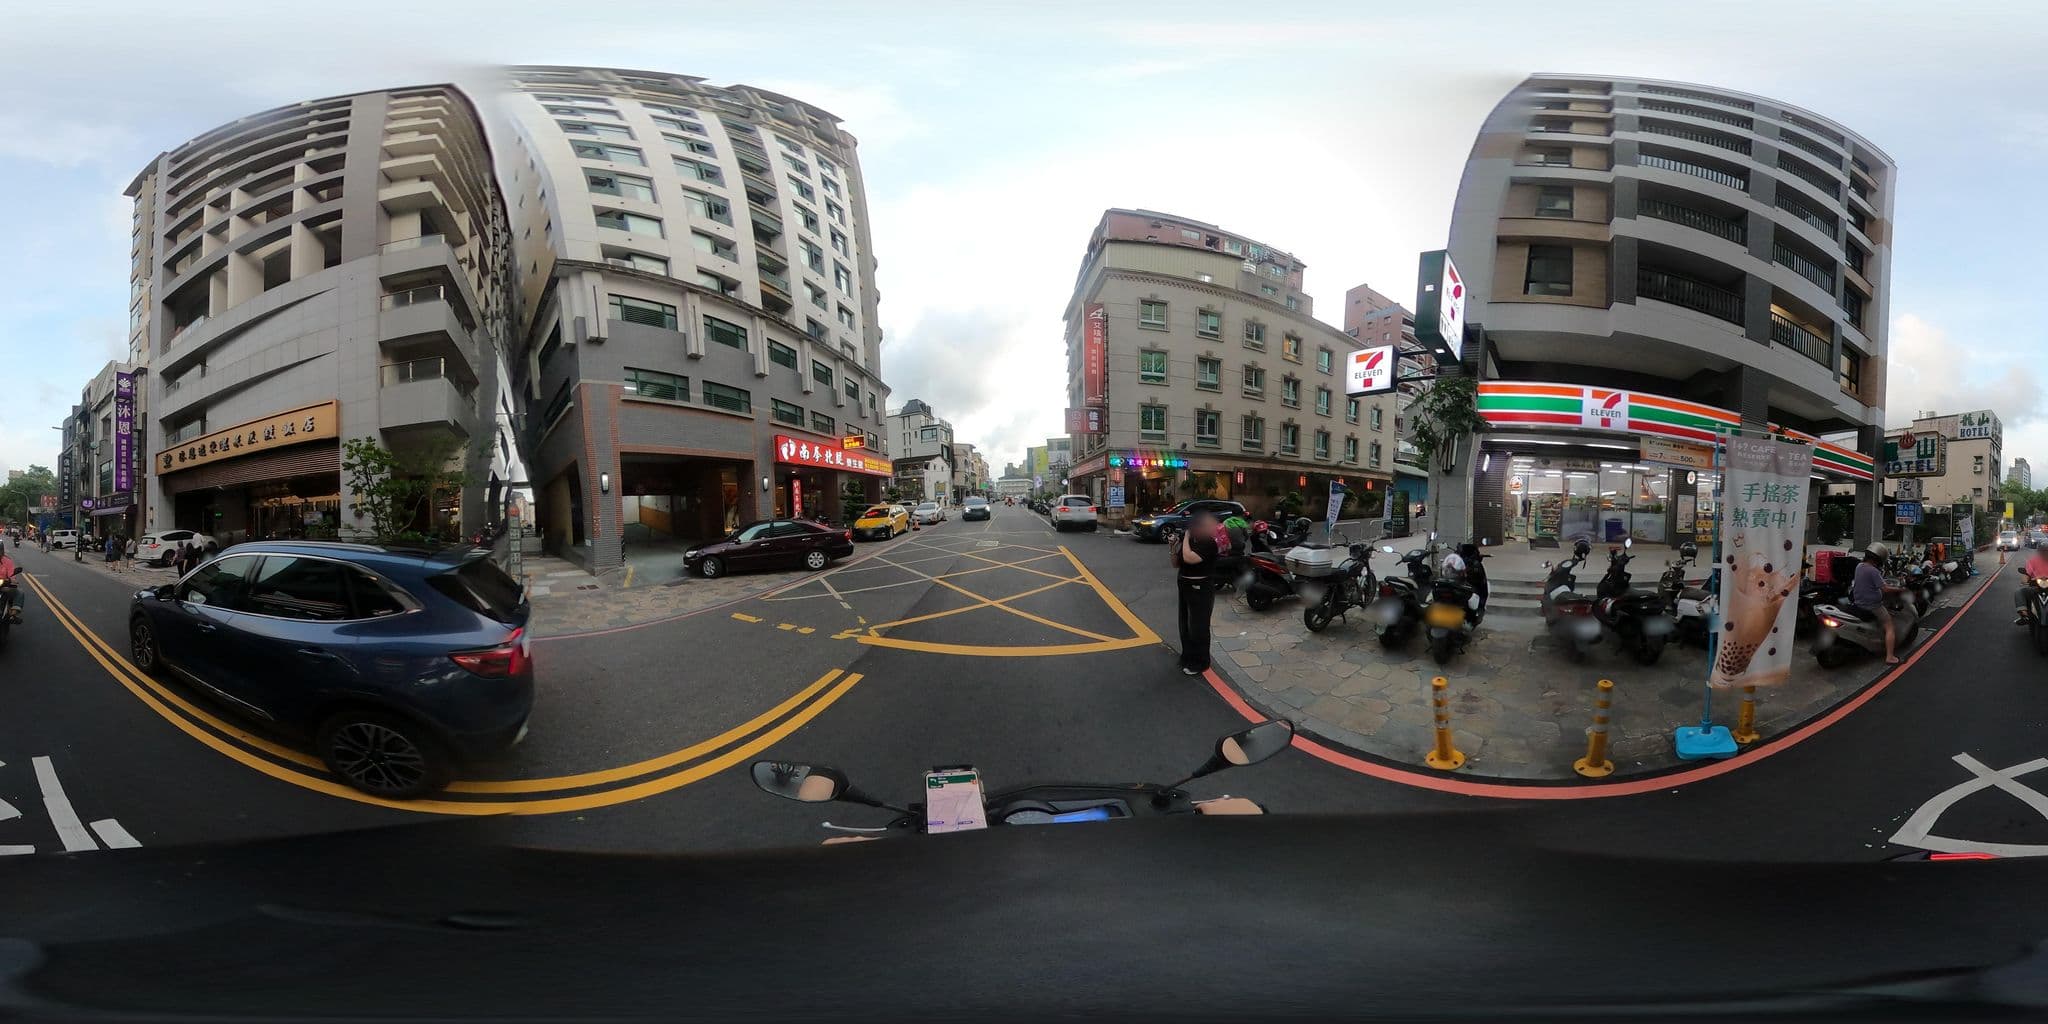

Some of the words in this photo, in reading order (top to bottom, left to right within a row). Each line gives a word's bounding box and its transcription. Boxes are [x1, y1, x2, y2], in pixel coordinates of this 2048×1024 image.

[1960, 427, 1989, 438] HOTEL
[1788, 452, 1807, 461] TEA
[1741, 482, 1800, 504] 手搖茶
[1731, 507, 1797, 529] 熱賣中!
